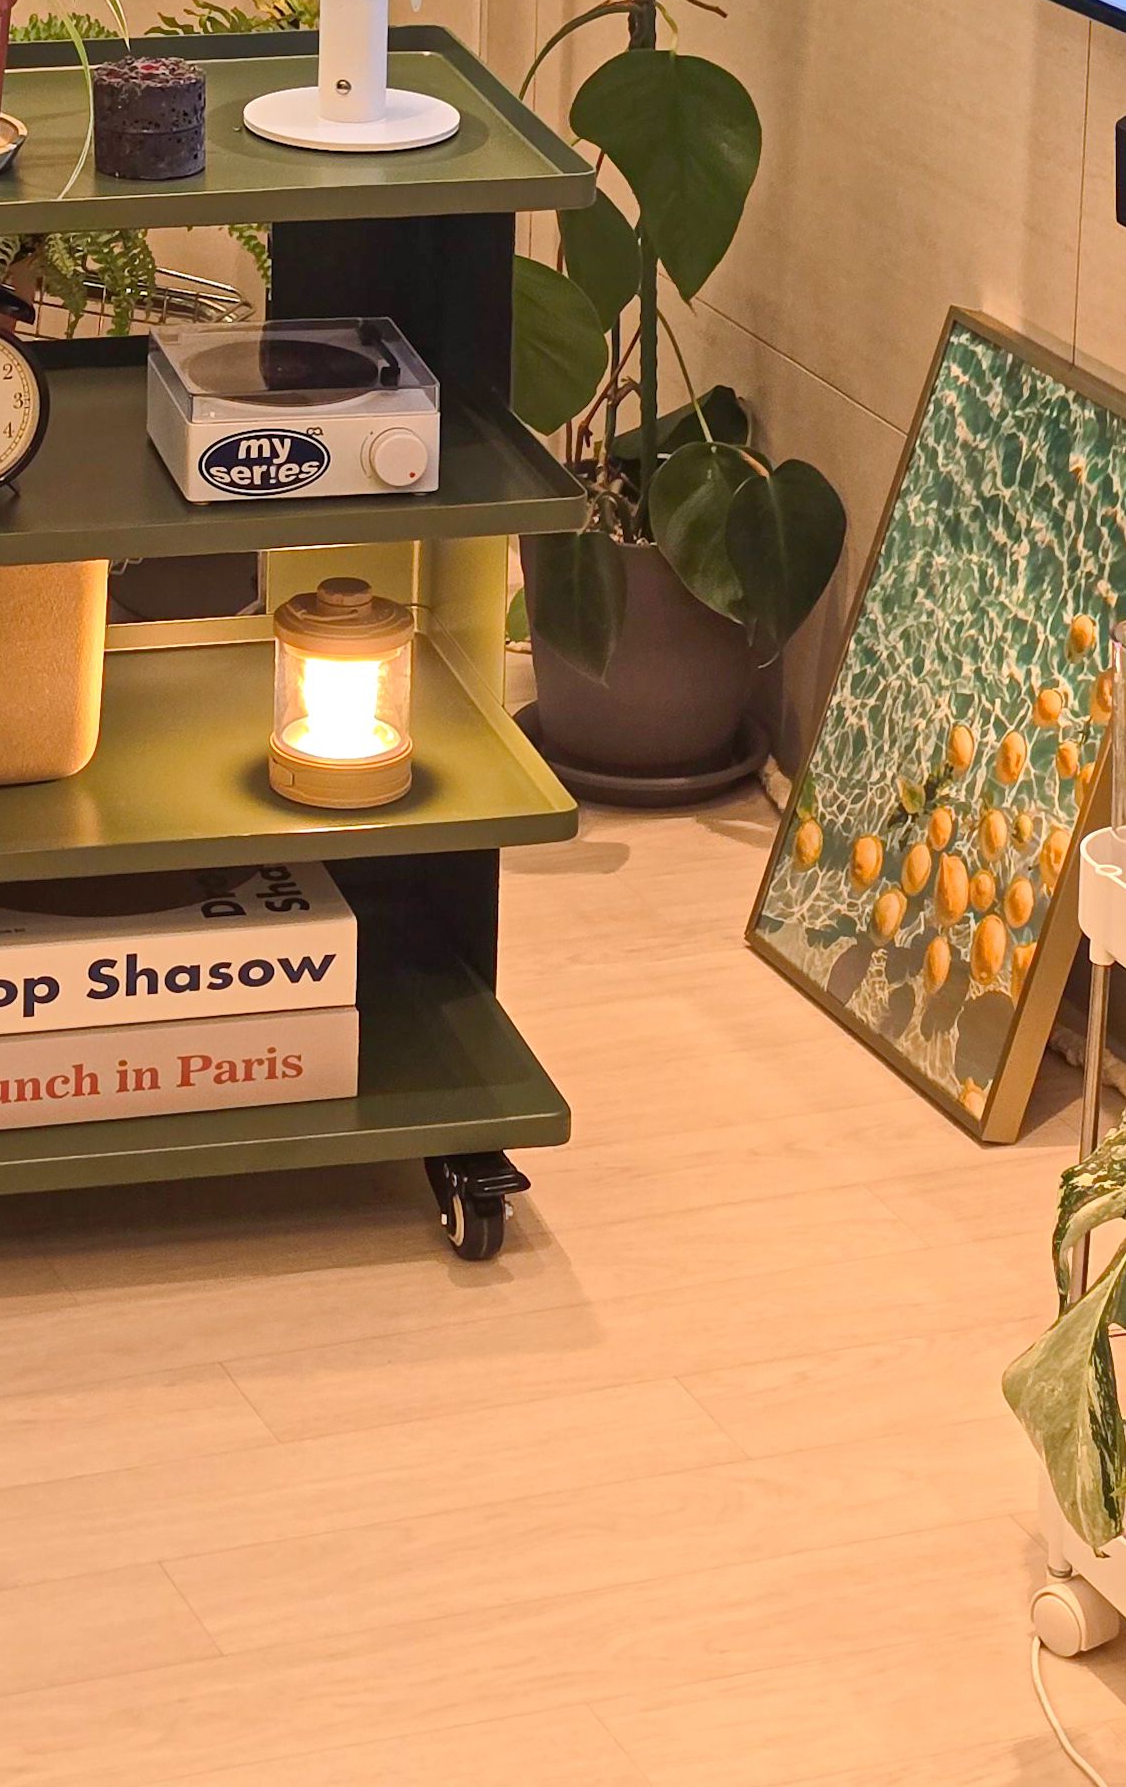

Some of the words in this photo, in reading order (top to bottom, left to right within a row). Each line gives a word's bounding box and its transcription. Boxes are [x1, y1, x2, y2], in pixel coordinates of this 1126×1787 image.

[3, 364, 13, 380] 2
[13, 392, 23, 409] 3
[3, 422, 14, 438] 4
[238, 438, 291, 464] my
[86, 953, 337, 1000] Shasow
[116, 1060, 161, 1093] in
[176, 1047, 304, 1088] Paris
